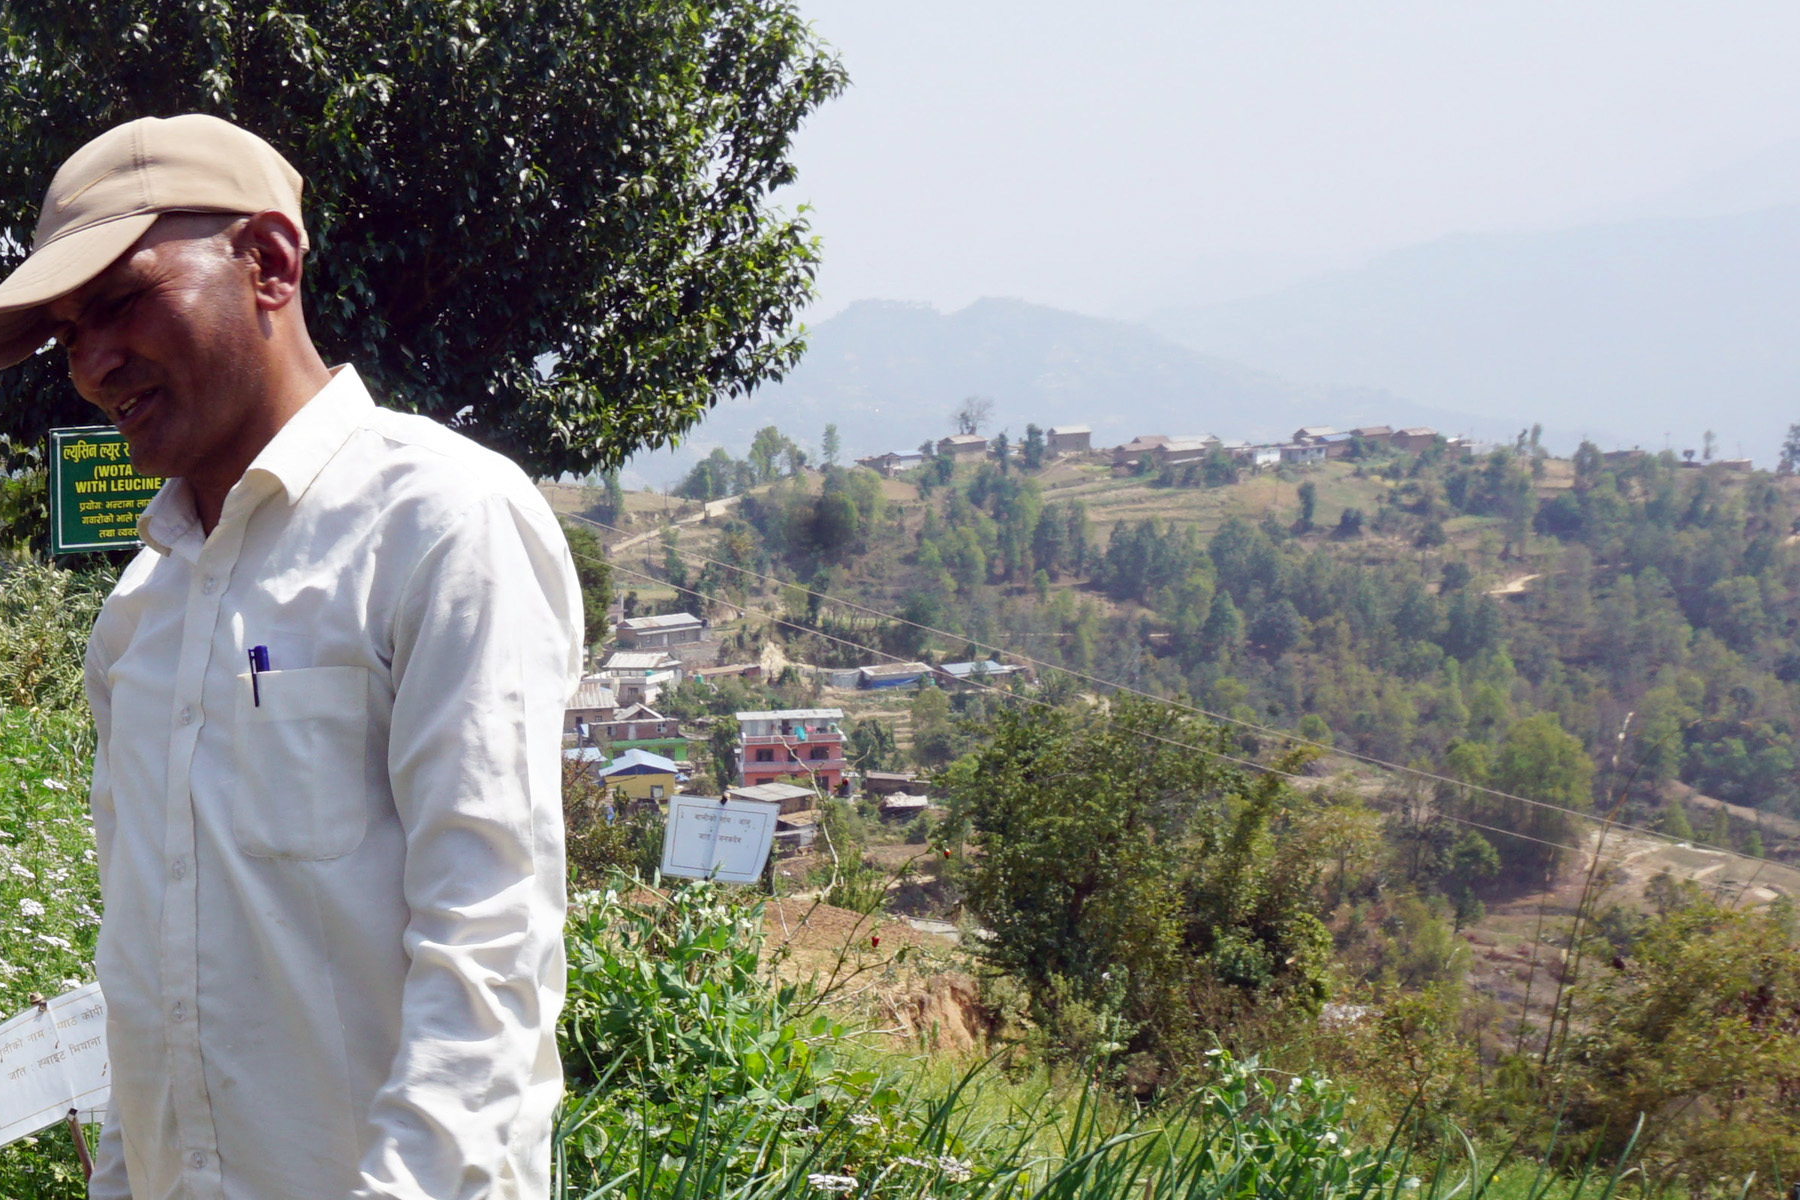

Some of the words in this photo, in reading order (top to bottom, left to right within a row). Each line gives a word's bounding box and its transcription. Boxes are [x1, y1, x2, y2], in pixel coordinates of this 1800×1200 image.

[94, 465, 133, 479] (WOTA
[75, 481, 106, 493] WITH
[111, 478, 161, 491] LEUCINE
[26, 1029, 45, 1045] नाम
